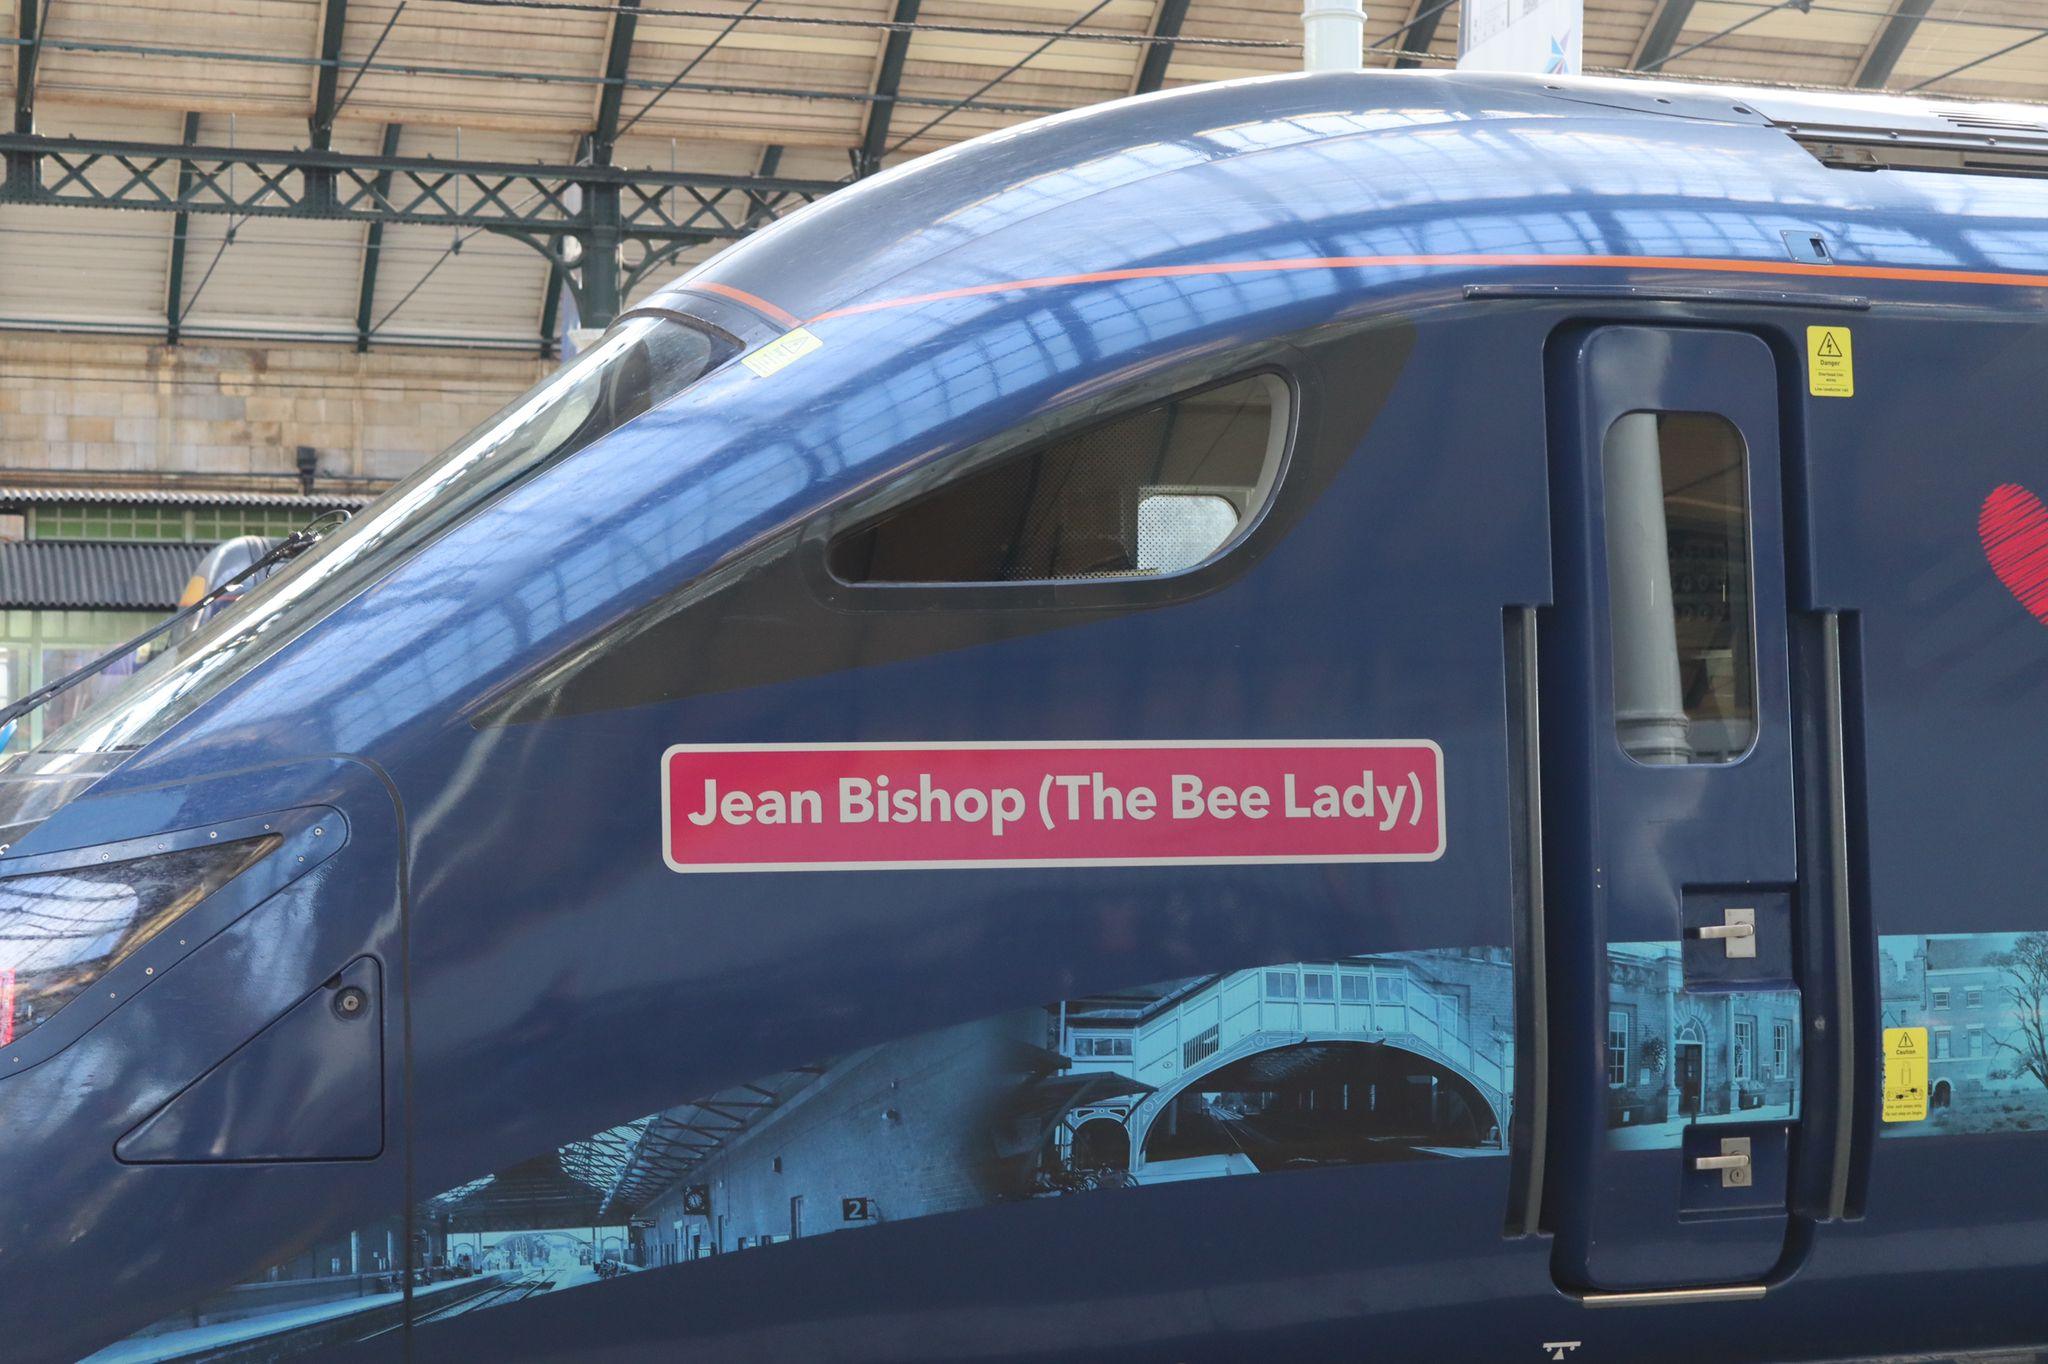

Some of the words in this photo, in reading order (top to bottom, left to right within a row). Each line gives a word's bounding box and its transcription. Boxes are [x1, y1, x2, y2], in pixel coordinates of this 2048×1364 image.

[1820, 359, 1841, 367] Danger
[687, 778, 823, 826] Jean
[838, 773, 1026, 837] Bishop
[1038, 771, 1158, 831] (The
[1171, 774, 1271, 821] Bee
[1283, 769, 1423, 832] Lady)
[848, 1200, 863, 1219] 2
